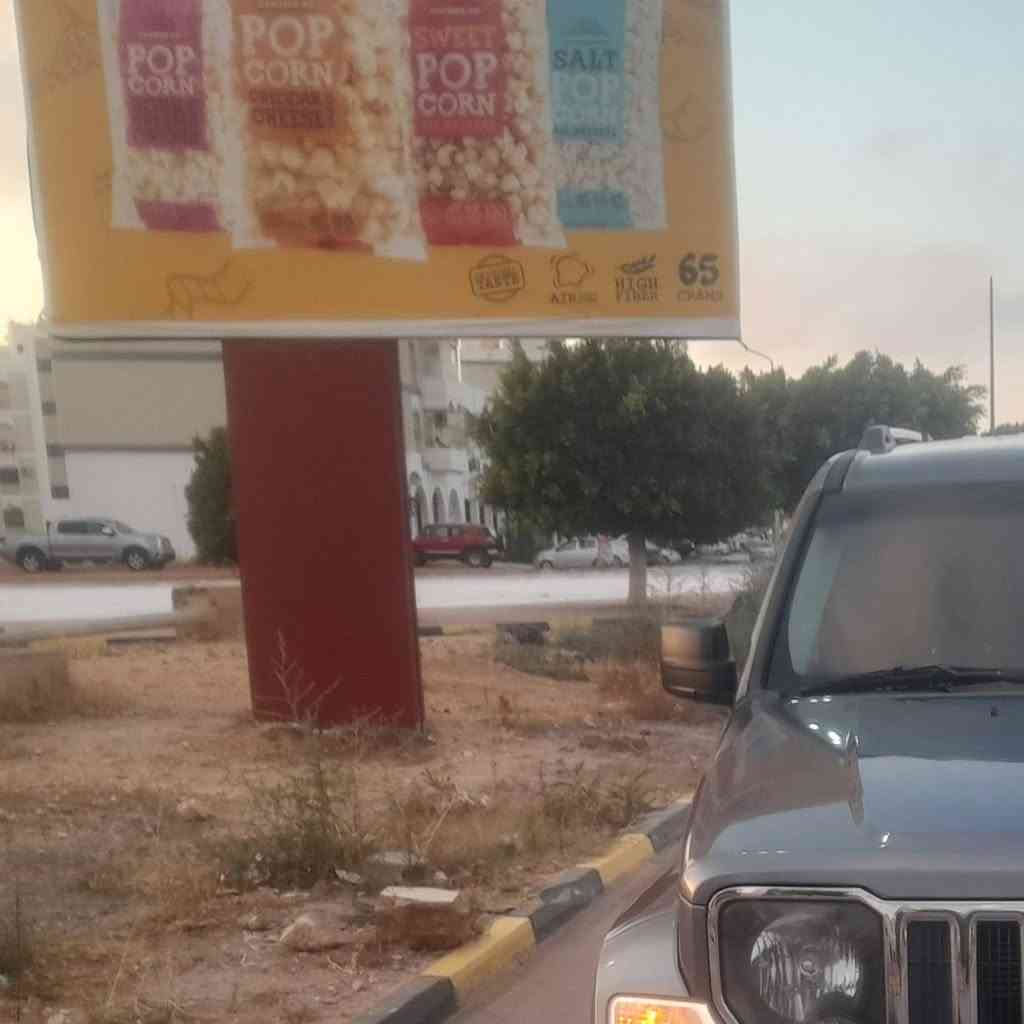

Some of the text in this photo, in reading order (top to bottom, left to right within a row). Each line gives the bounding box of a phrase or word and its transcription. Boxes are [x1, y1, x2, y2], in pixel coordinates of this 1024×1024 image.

[241, 14, 335, 57] POP
[414, 25, 496, 48] SWEET
[127, 45, 195, 77] POP
[416, 52, 497, 89] POP
[553, 48, 619, 71] SALT
[127, 76, 195, 97] CORN
[244, 60, 334, 90] CORN
[553, 72, 620, 102] POP
[417, 93, 496, 117] CORN
[679, 252, 720, 287] 65
